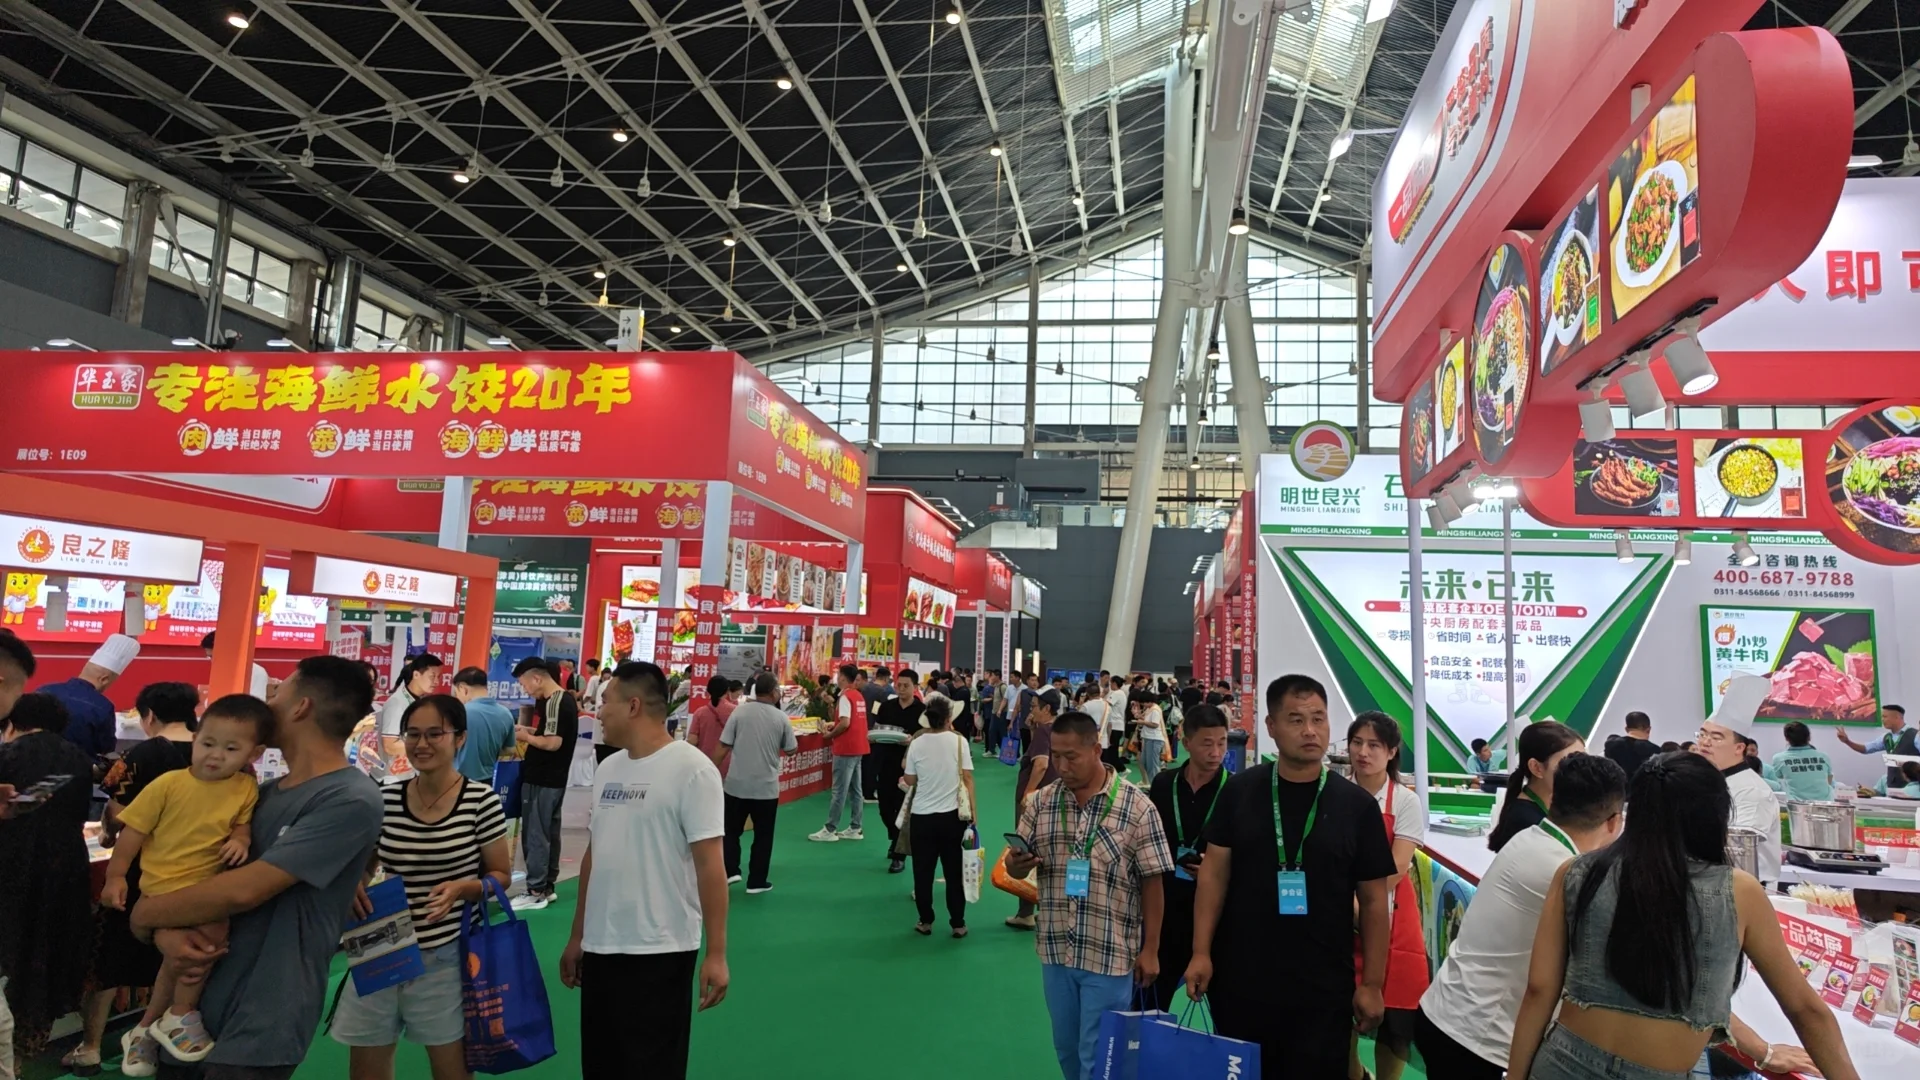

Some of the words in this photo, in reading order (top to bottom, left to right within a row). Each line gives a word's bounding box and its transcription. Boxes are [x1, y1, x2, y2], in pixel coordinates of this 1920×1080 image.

[78, 367, 137, 392] 华玉家
[146, 363, 632, 414] 专注海鲜水饺20年
[81, 395, 100, 405] HUA
[102, 396, 114, 405] YU
[115, 396, 133, 405] JIA
[242, 429, 281, 440] 当日新肉
[373, 429, 413, 441] 当日采摘
[539, 430, 581, 442] 优质产地
[371, 440, 412, 451] 当日使用
[538, 441, 581, 453] 品质可靠
[1281, 486, 1360, 506] 明世良兴
[1281, 506, 1315, 514] MINGSHI
[1291, 526, 1372, 536] MINGSHILIANGXING
[62, 533, 131, 561] 良之隆
[384, 573, 420, 592] 良之隆
[1714, 569, 1854, 586] 400-687-9788
[1714, 588, 1780, 597] 0311-84568666
[1436, 631, 1472, 643] 省时间
[1535, 635, 1572, 647] 出餐快
[1737, 635, 1768, 648] 小炒
[1716, 647, 1769, 663] 黄牛肉
[1430, 656, 1472, 667] 食品安全
[1430, 669, 1472, 681] 降低成本
